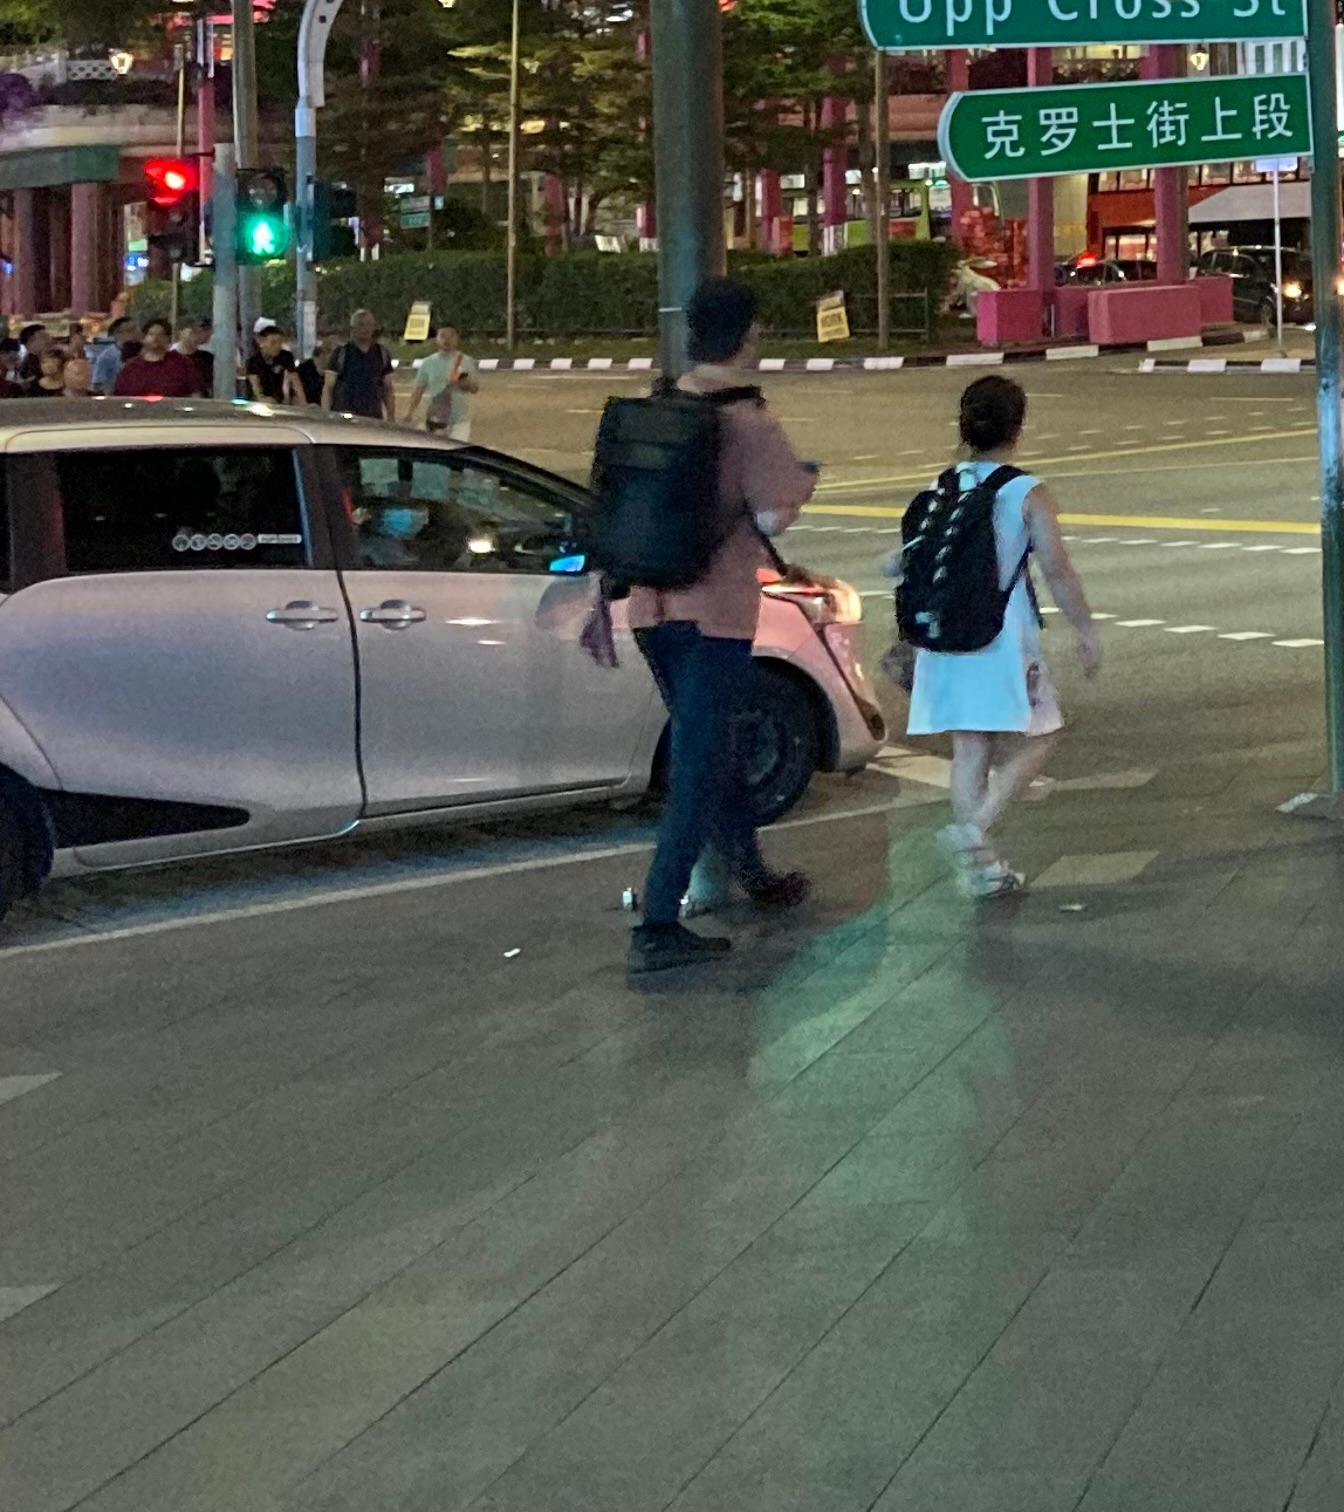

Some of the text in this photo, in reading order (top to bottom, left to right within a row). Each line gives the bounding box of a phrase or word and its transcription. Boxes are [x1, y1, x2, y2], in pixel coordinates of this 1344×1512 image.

[981, 93, 1294, 159] 克罗士街上段
